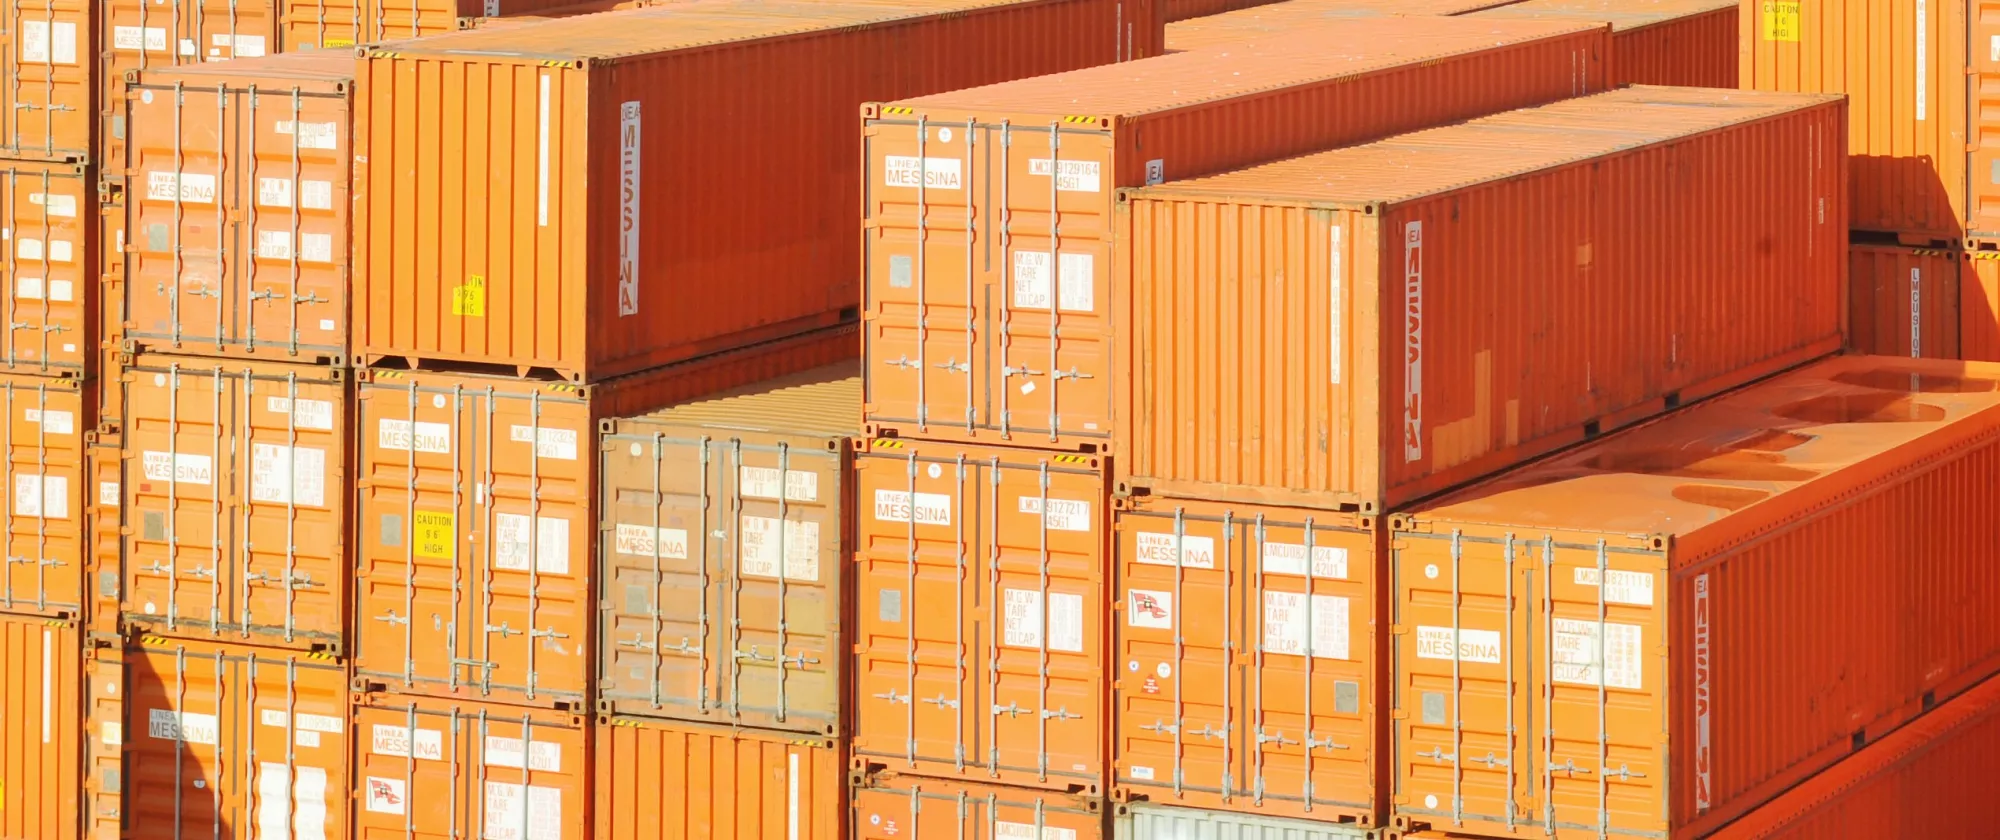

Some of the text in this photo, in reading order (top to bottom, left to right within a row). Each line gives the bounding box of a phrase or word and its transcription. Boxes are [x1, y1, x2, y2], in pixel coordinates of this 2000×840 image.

[1764, 5, 1798, 14] CUTON
[888, 160, 921, 169] LINEA
[888, 170, 958, 186] MESSINA
[148, 184, 214, 198] MESSINA
[1016, 266, 1037, 280] TARE
[1016, 280, 1031, 293] NET
[380, 431, 446, 449] MESSINA
[143, 463, 209, 480] MESSINA
[877, 492, 910, 503] LINEA
[877, 503, 948, 522] MESSINA
[416, 514, 451, 527] CAUTION
[618, 528, 648, 537] LINEA
[618, 537, 685, 555] MESSINA
[1138, 535, 1172, 546] LINEA
[424, 543, 443, 554] HIGH
[744, 546, 759, 558] NET
[1138, 546, 1212, 565] MESSINA
[1313, 562, 1338, 577] 42U1
[1005, 604, 1027, 618] TARE
[1267, 608, 1288, 622] TARE
[1005, 617, 1021, 630] NET
[1266, 622, 1282, 637] NET
[1418, 631, 1453, 641] LINEA
[1418, 641, 1499, 660] MESSINA
[1555, 636, 1580, 651] TARE
[150, 711, 177, 721] LINEA
[150, 721, 214, 741] MESSINA
[374, 728, 404, 738] LINEA
[374, 738, 439, 756] MESSINA
